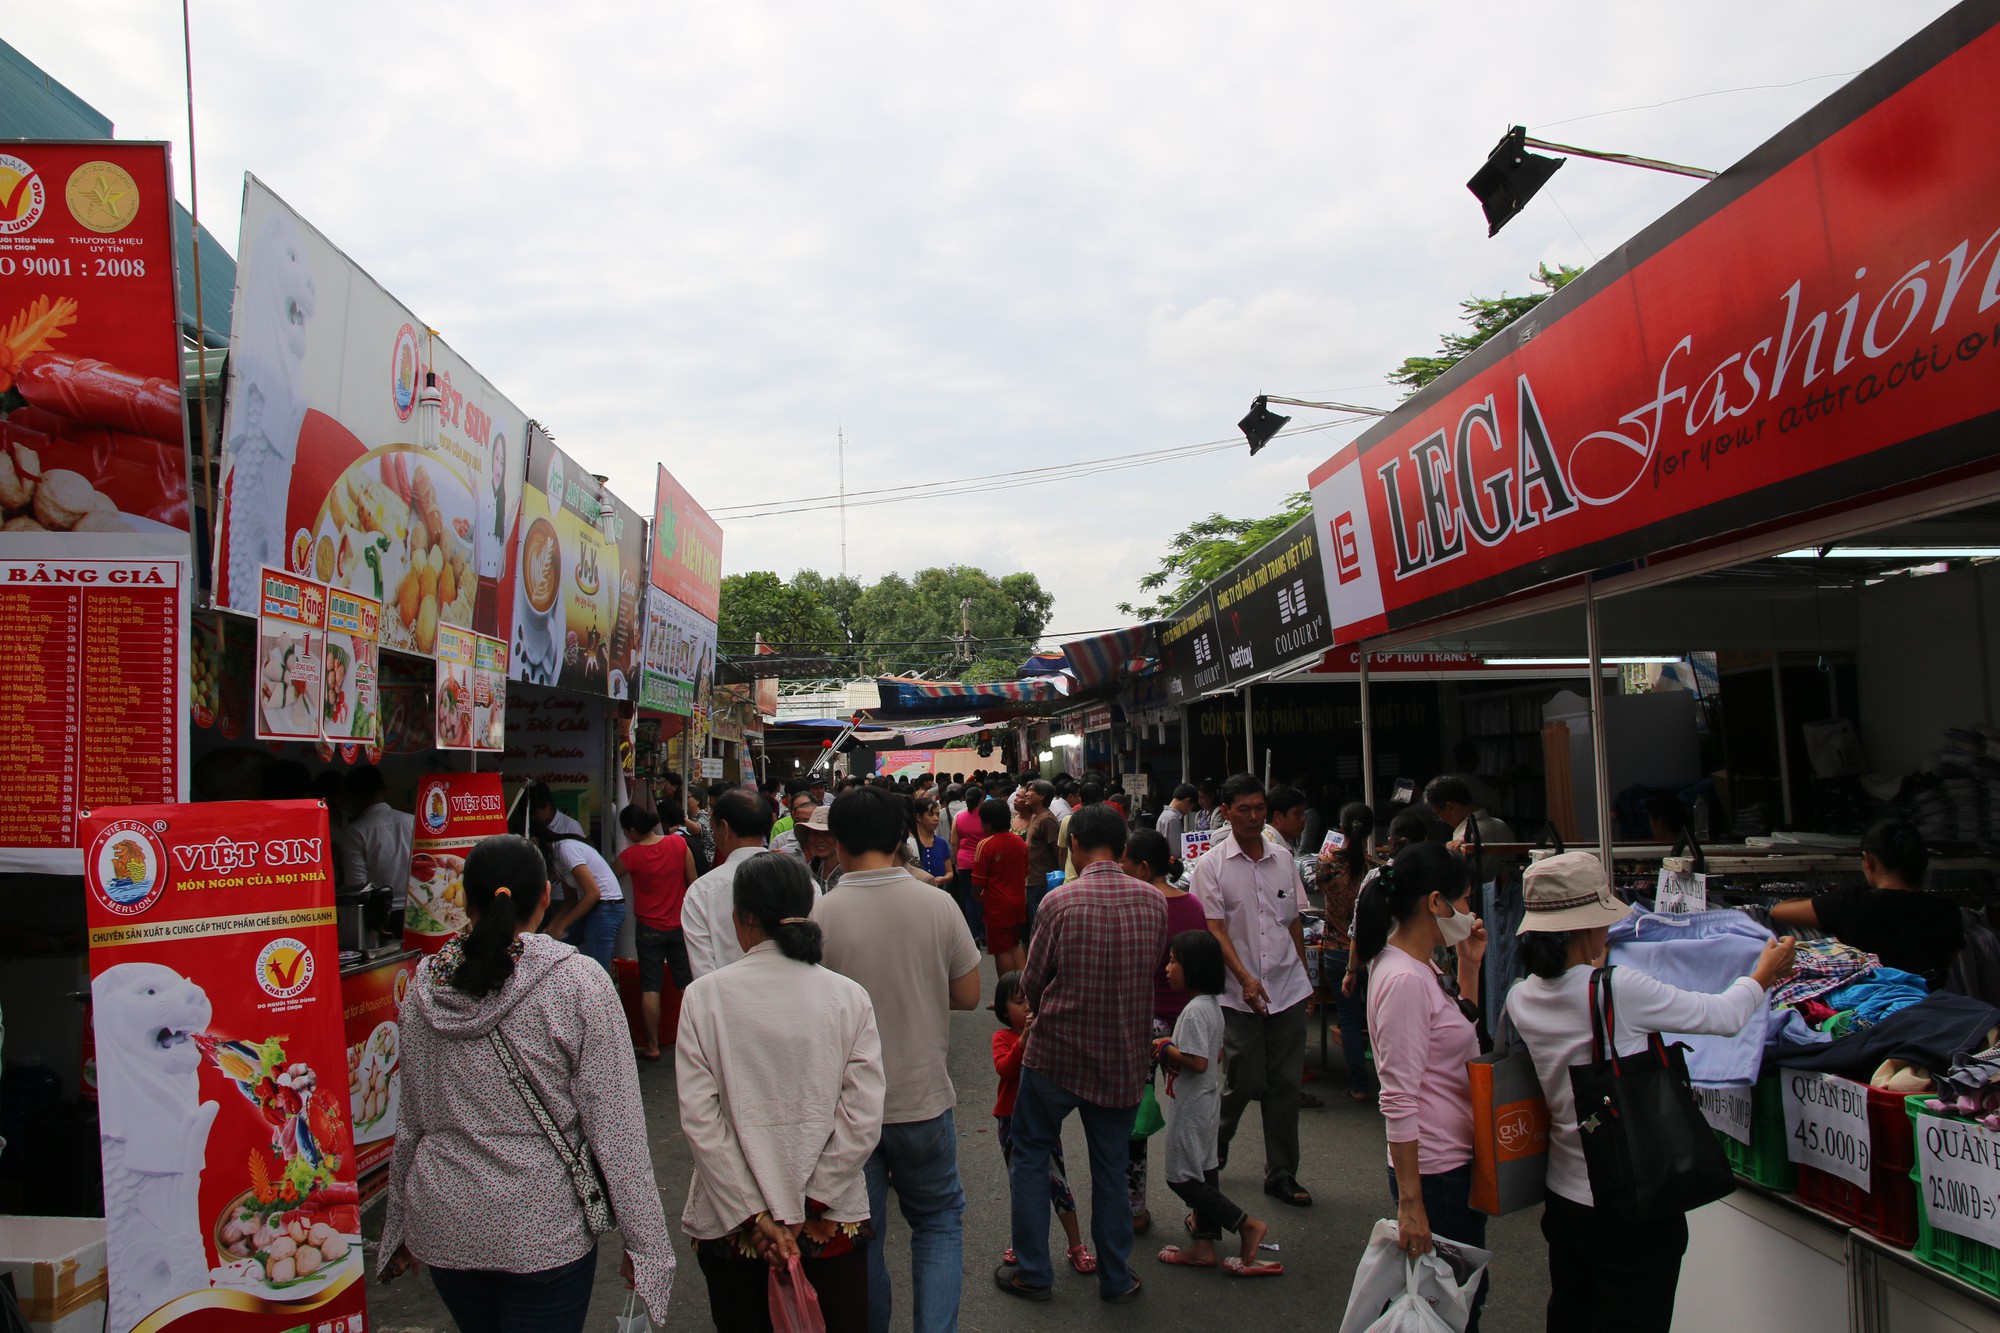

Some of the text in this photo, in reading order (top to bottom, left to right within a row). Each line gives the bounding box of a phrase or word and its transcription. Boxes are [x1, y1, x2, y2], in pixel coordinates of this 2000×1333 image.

[69, 236, 116, 245] THƯƠNG
[90, 245, 104, 253] UY
[23, 258, 71, 276] 9001
[95, 259, 145, 277] 2008
[464, 401, 491, 450] SIN
[1653, 448, 1691, 489] for
[1700, 416, 1766, 471] your
[1378, 373, 1578, 581] LEGA
[1267, 554, 1287, 581] TRANG
[1285, 542, 1300, 571] VIỆT
[1299, 533, 1313, 561] TÂY
[8, 563, 165, 584] BẢNG GIÁ
[68, 605, 77, 613] 21k
[164, 607, 173, 615] 63k
[300, 591, 325, 621] Tặng
[67, 625, 77, 633] 53k
[68, 615, 77, 623] 61k
[163, 627, 173, 635] 79k
[302, 630, 311, 659] 1
[1377, 652, 1392, 663] CP
[1429, 651, 1467, 662] TRANG
[1201, 705, 1232, 737] CÔNG
[1253, 697, 1268, 734] CỔ
[1272, 699, 1303, 733] PHẦN
[450, 792, 501, 814] VIỆT SIN
[131, 822, 148, 835] SIN
[173, 836, 322, 874] VIỆT SIN
[176, 869, 326, 891] MÓN NGON CỦA MỌI NHÀ
[107, 897, 152, 913] MERLION
[92, 912, 332, 942] CHUYÊN SẢN XUẤT & CUNG CẤP THỰC PHẨM CHẾ BIẾN, ĐÔNG LẠNH
[282, 940, 303, 951] NAM
[1842, 1088, 1865, 1122] ĐÙI
[1499, 1116, 1529, 1144] gsk
[1794, 1118, 1869, 1172] 45.000 Đ
[1926, 1124, 1990, 1169] QUẦN
[1929, 1174, 1981, 1220] 25.000 Đ
